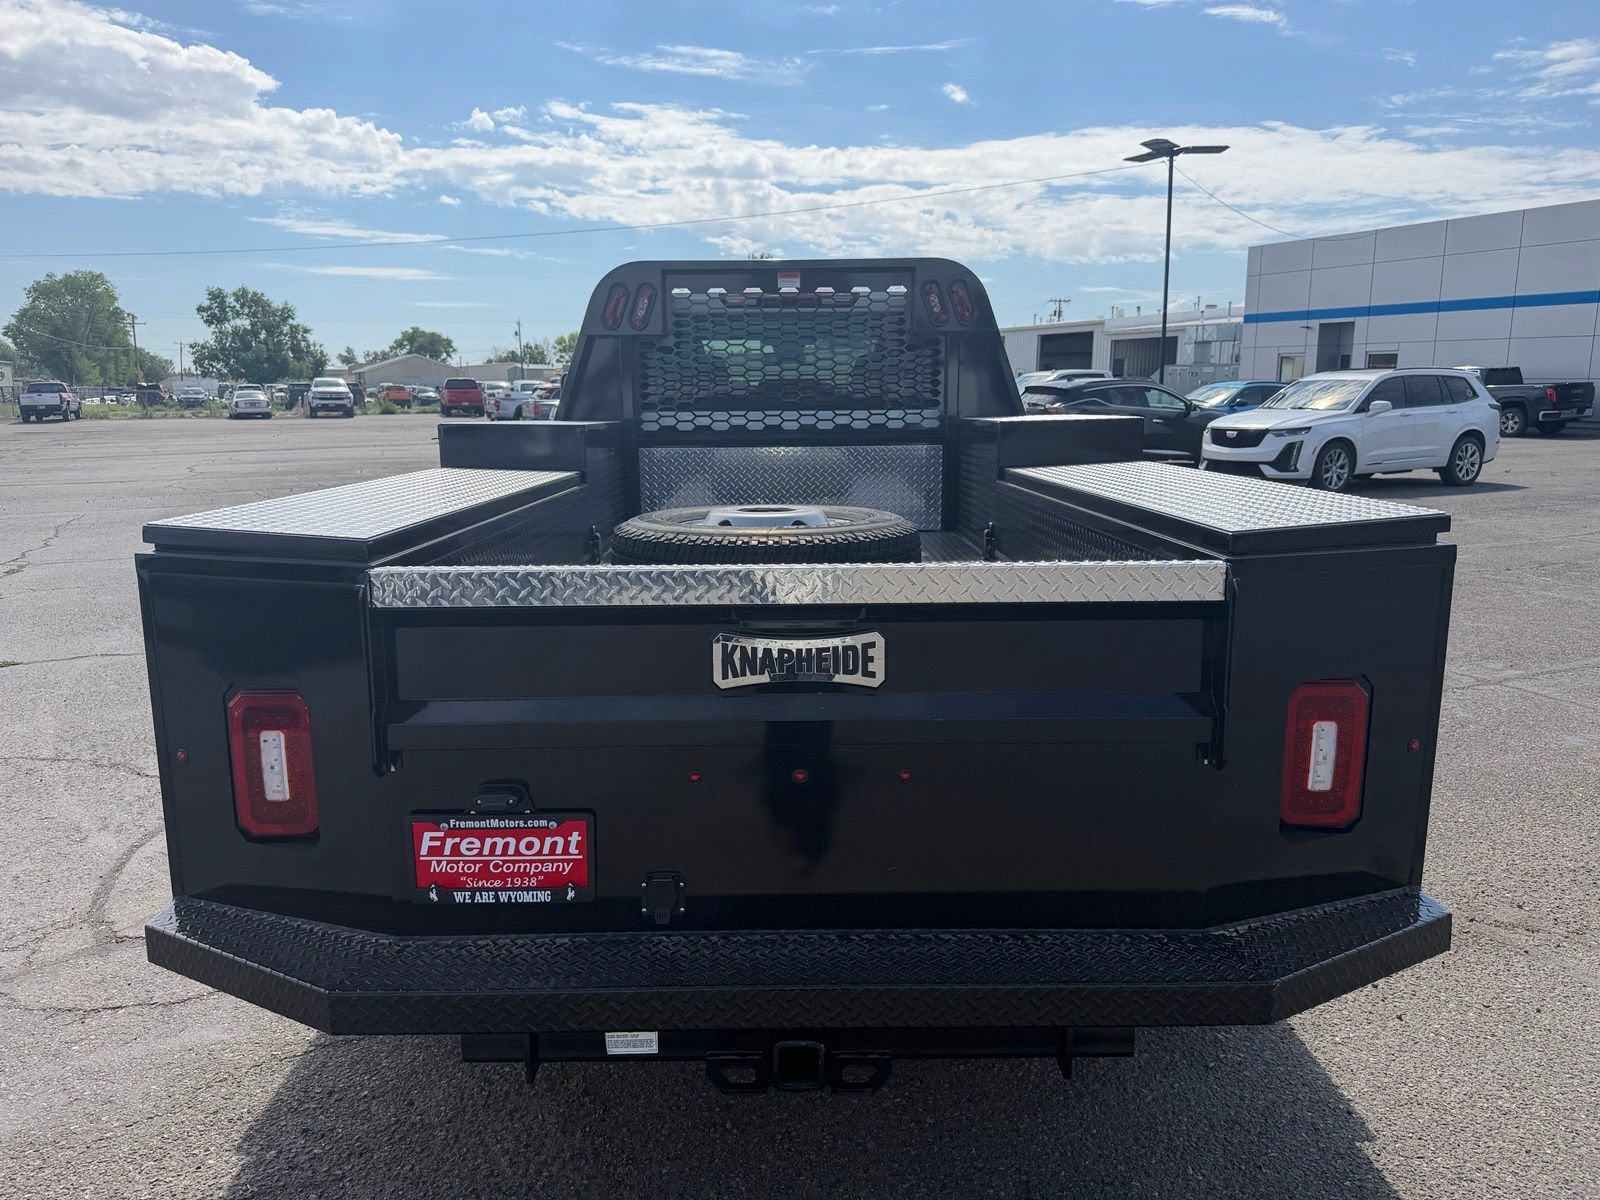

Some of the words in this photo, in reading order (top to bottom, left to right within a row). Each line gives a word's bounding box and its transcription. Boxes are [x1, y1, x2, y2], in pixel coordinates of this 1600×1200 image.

[721, 640, 877, 680] KNAPHEIDE
[449, 819, 548, 829] FremontMotors.com
[419, 831, 582, 856] Fremont
[430, 860, 483, 873] Motor
[489, 860, 574, 875] Company
[453, 891, 473, 903] WE
[474, 891, 496, 903] ARE
[499, 890, 551, 903] WYOMING
